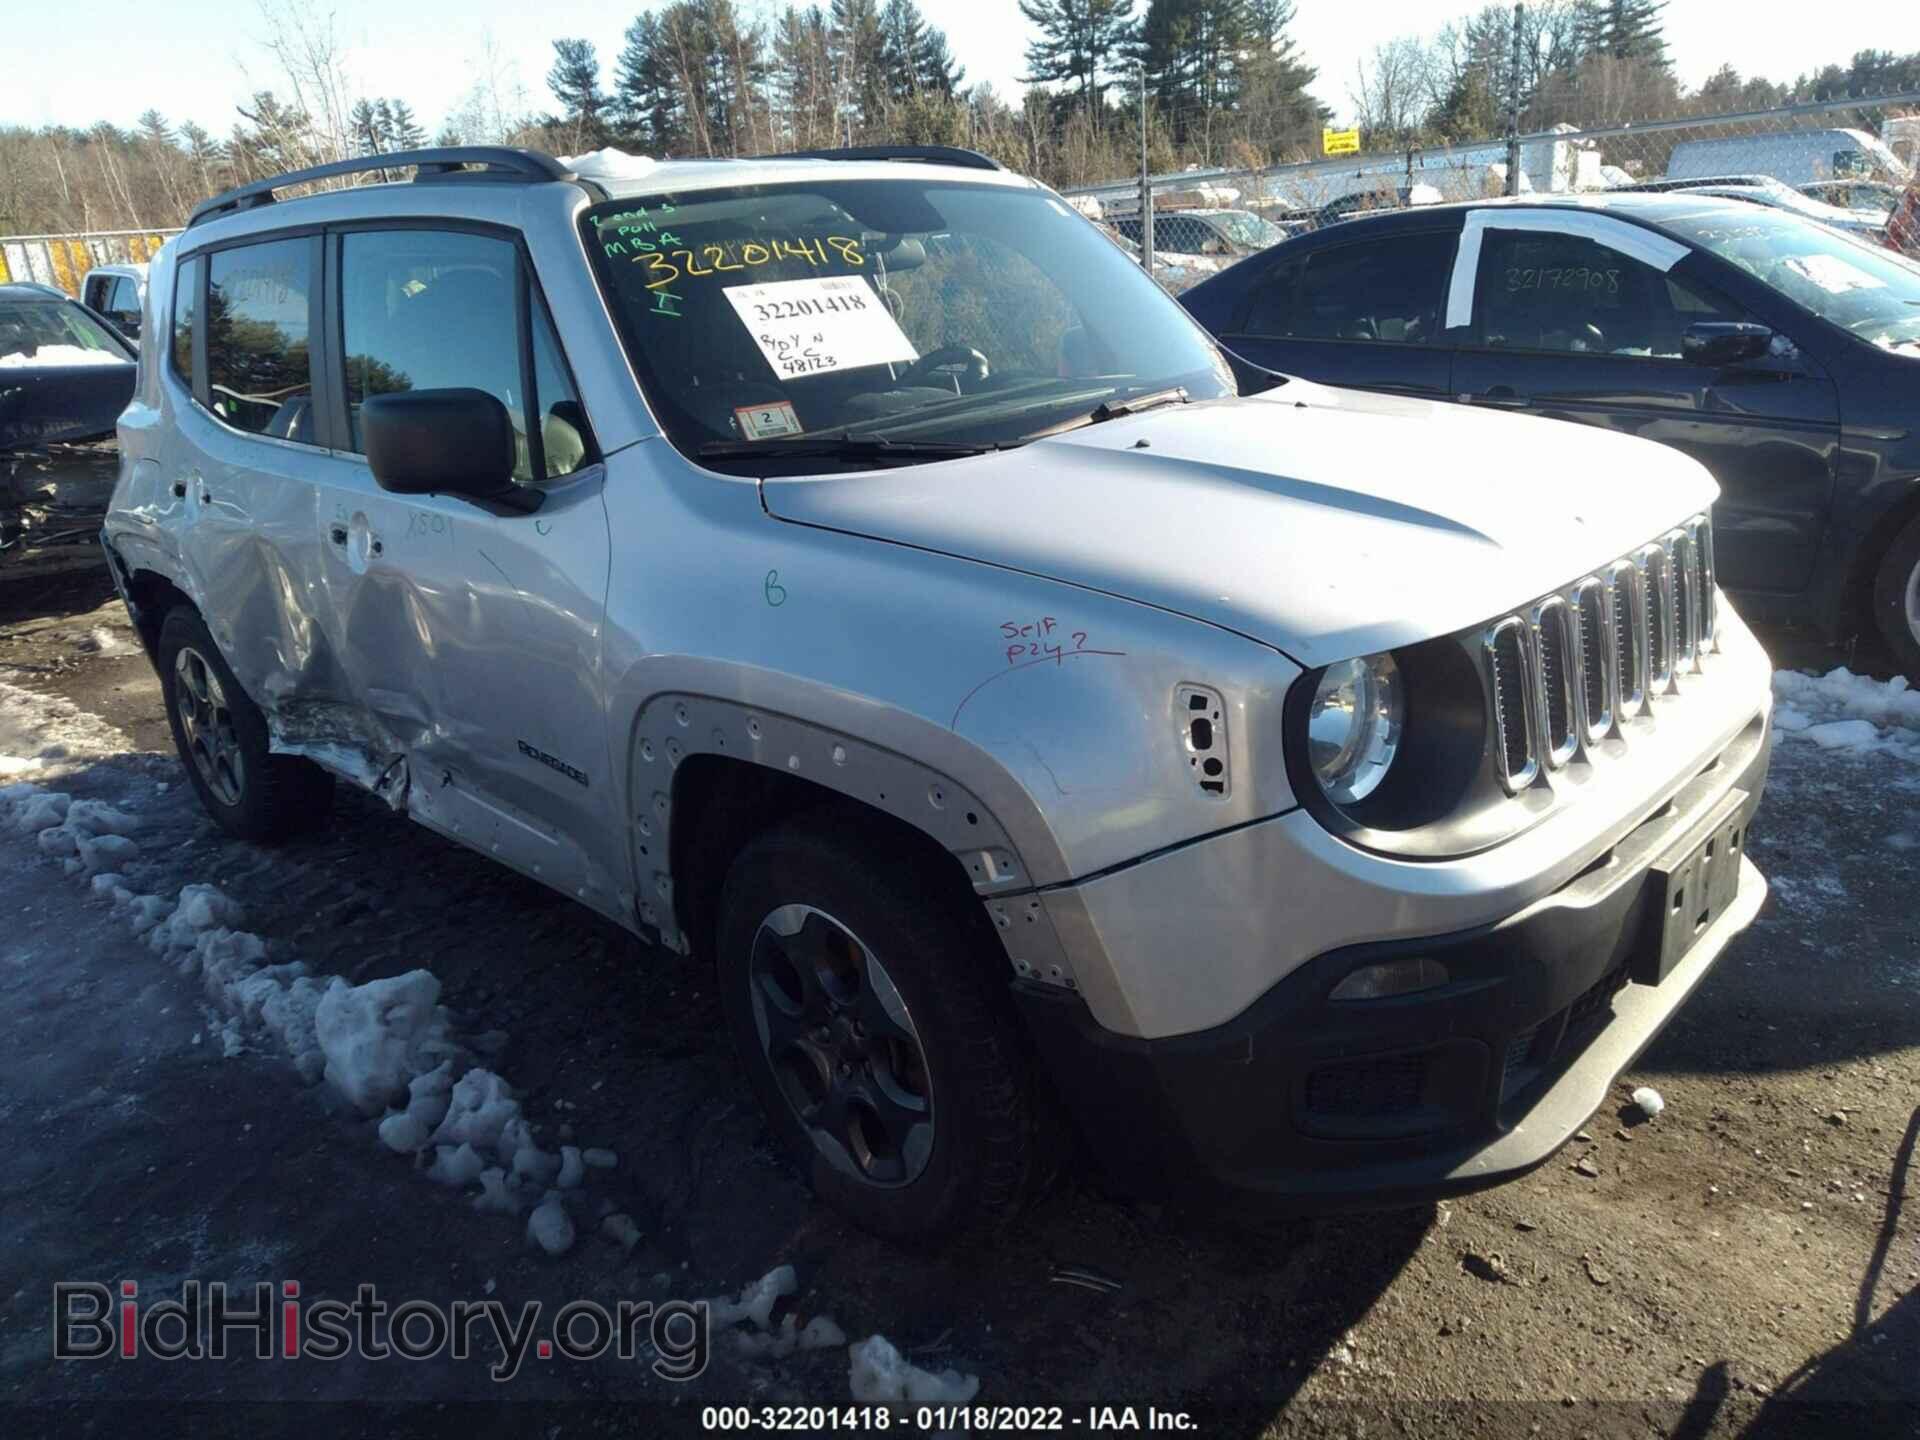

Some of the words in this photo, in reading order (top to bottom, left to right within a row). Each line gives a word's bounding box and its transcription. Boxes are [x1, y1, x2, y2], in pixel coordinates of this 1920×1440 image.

[631, 236, 864, 289] 32201418
[1505, 265, 1619, 293] 32172908
[753, 294, 867, 322] 32201418
[782, 355, 838, 375] 48123
[760, 412, 773, 424] 2
